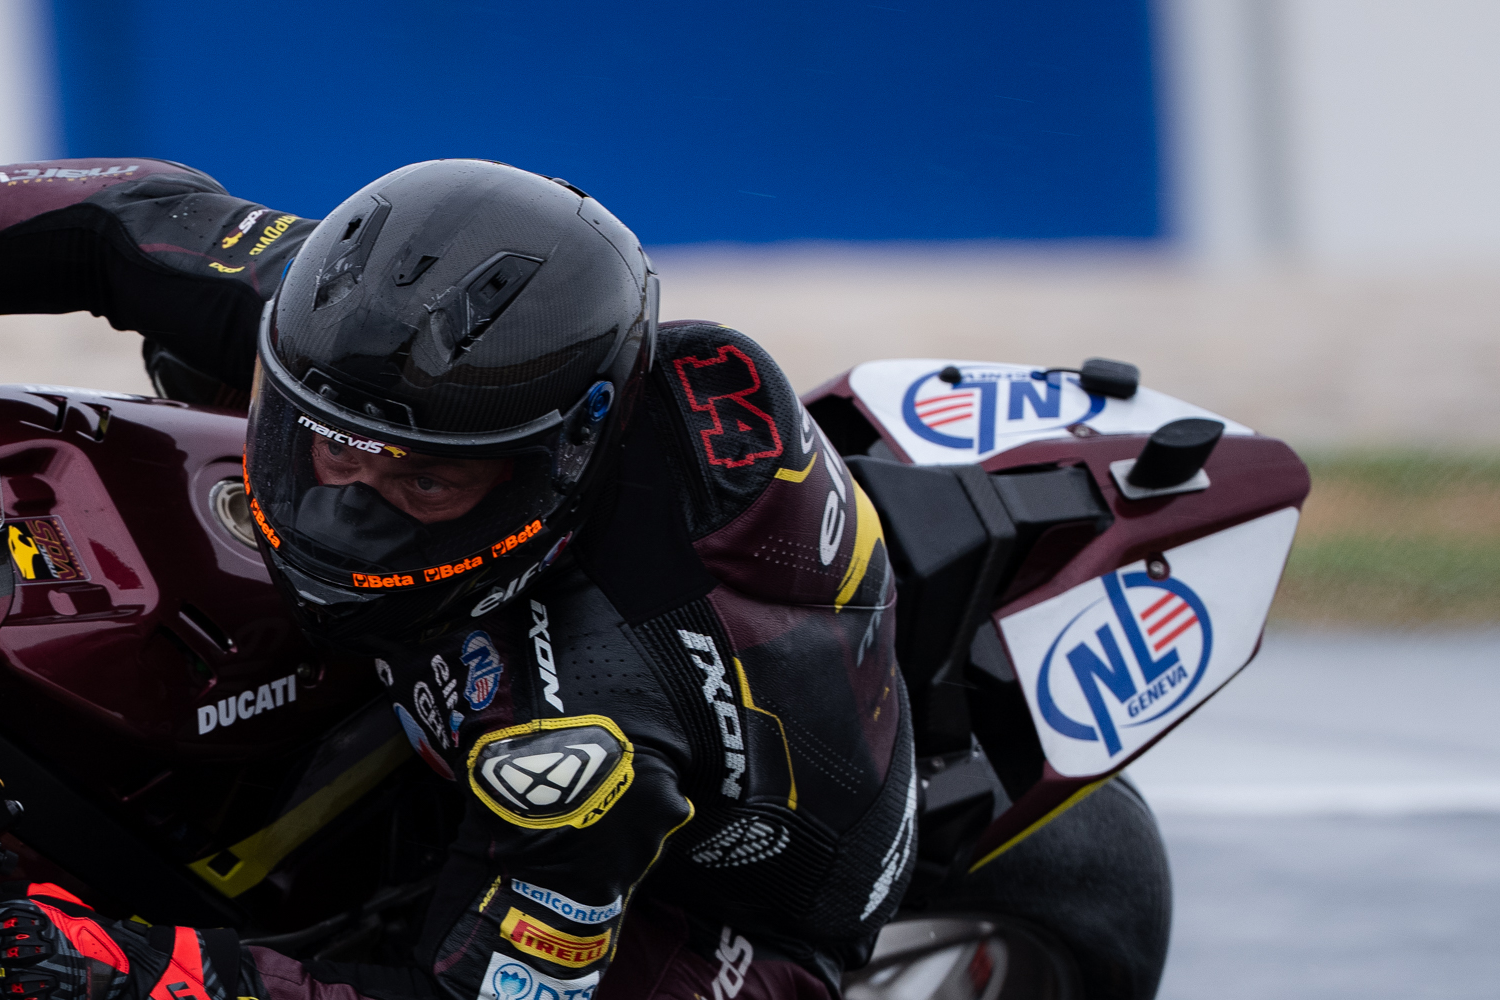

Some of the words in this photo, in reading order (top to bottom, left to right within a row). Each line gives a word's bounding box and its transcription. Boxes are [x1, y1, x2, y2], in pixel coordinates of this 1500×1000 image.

[673, 344, 784, 469] 14
[255, 510, 281, 549] Beta
[504, 518, 543, 550] Beta
[367, 573, 415, 589] Beta
[438, 556, 484, 580] Beta
[470, 562, 540, 618] elf
[1064, 570, 1181, 759] NL
[196, 673, 298, 736] DUCATI
[1126, 664, 1189, 719] GENEVA
[510, 918, 606, 962] PIRELLI
